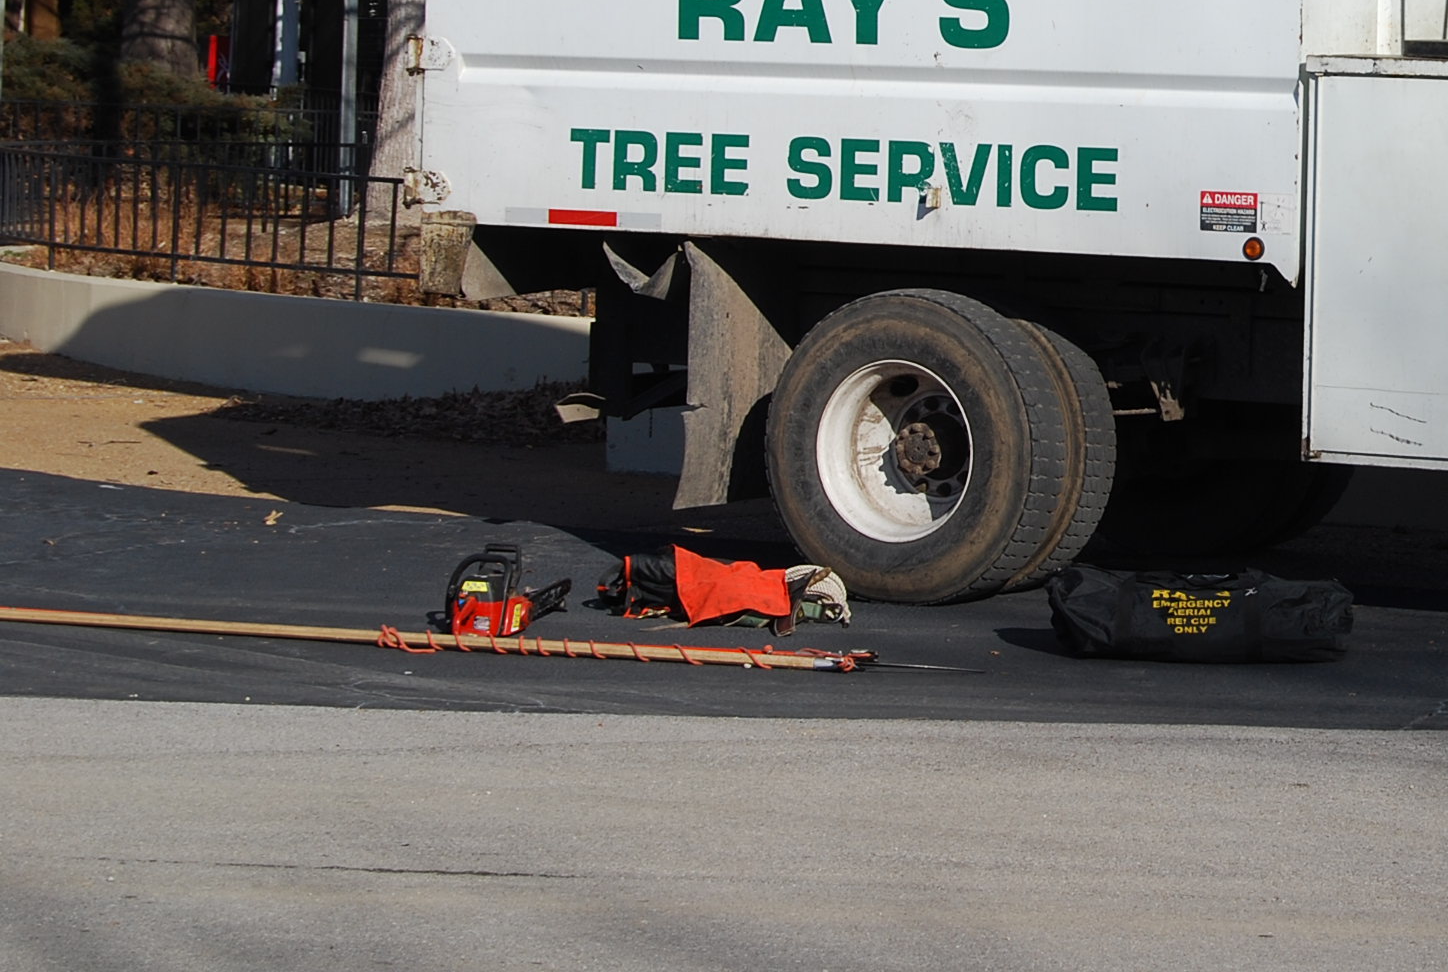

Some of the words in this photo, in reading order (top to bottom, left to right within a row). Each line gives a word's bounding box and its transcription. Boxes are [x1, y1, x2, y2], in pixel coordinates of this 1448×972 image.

[569, 127, 751, 197] TREE
[785, 135, 1120, 213] SERVICE
[1214, 194, 1255, 205] DANGER
[1152, 599, 1231, 608] EMERGENCY
[1174, 626, 1208, 634] ONLY
